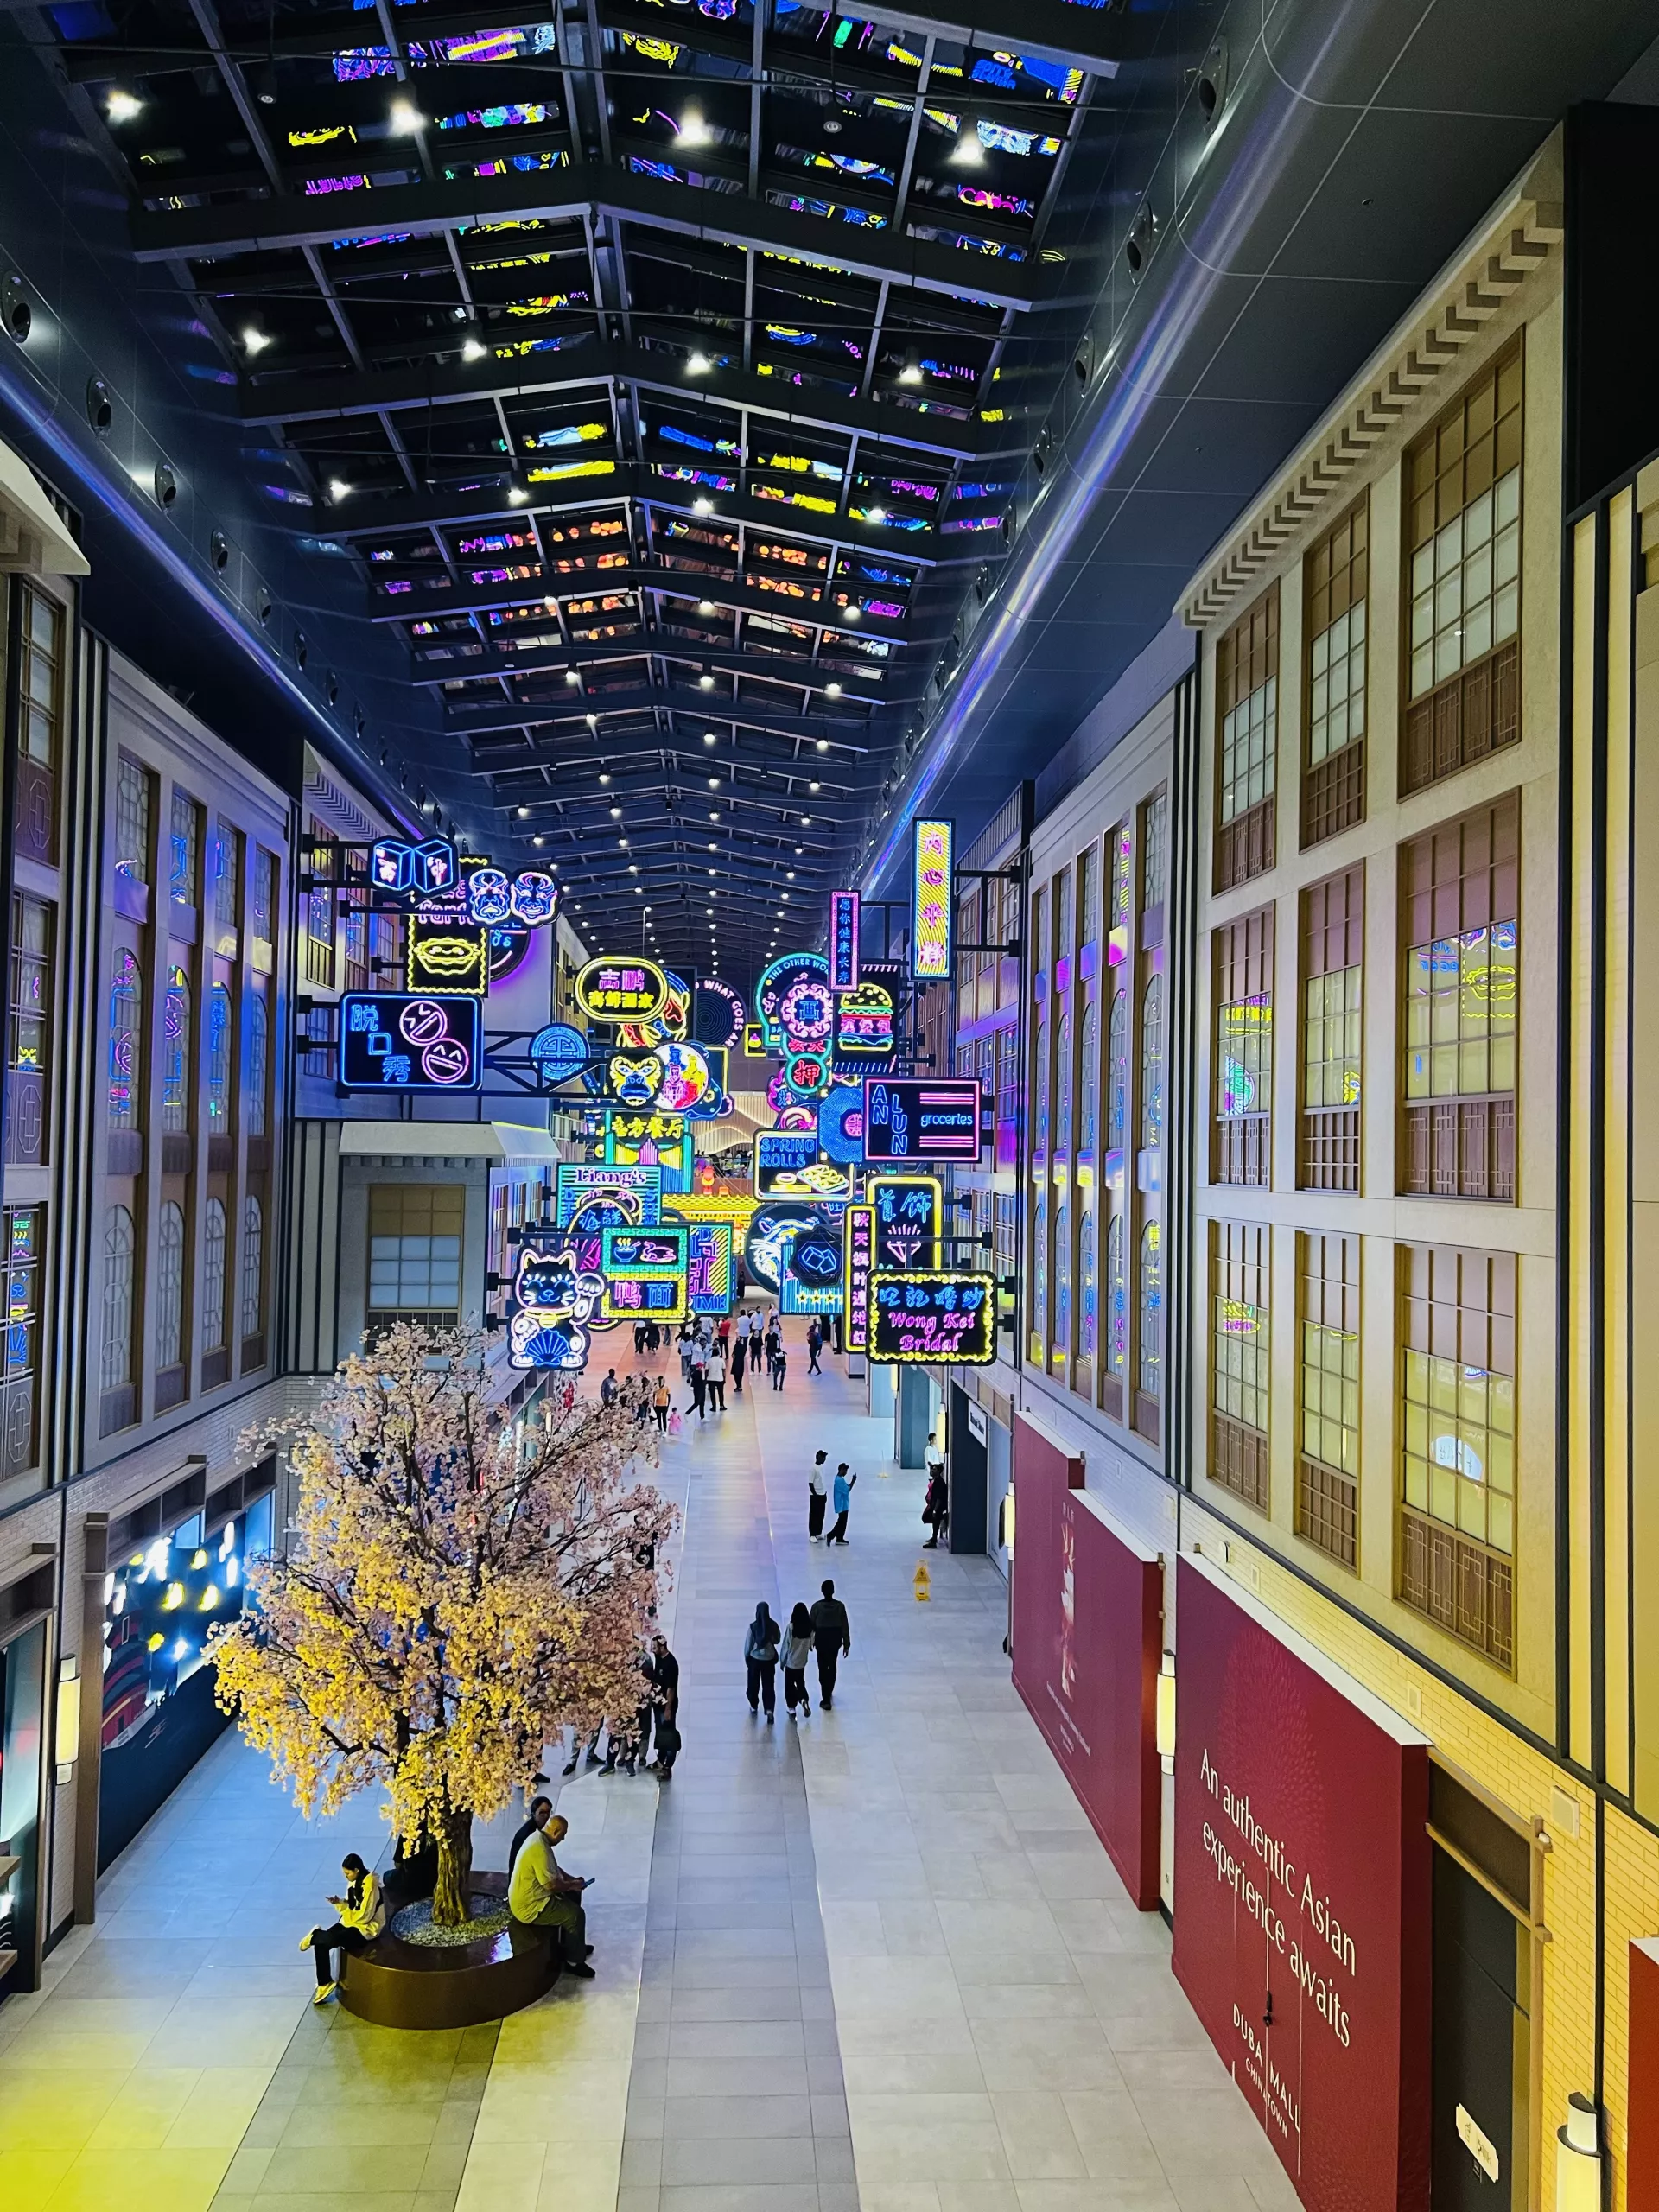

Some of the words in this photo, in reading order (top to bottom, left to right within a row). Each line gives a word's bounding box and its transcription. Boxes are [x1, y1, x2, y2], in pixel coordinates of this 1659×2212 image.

[919, 830, 945, 966] 内心平静
[837, 898, 851, 984] 愿你健康长寿
[768, 965, 783, 981] THE
[783, 958, 810, 969] OTHER
[703, 979, 735, 1000] WHAT
[731, 1001, 745, 1031] GOES
[351, 1003, 410, 1082] 脱口秀
[793, 1058, 821, 1087] 押
[920, 1113, 974, 1128] groceries
[760, 1137, 815, 1153] SPRING
[760, 1153, 806, 1167] ROLLS
[574, 1166, 647, 1188] Liang's
[613, 1281, 674, 1309] 鸭面
[692, 1296, 727, 1311] IME
[888, 1312, 938, 1335] Wong
[943, 1311, 976, 1330] Kei
[899, 1332, 963, 1352] Bridal
[1200, 1748, 1219, 1800] An
[1223, 1784, 1296, 1898] authentic
[1301, 1872, 1356, 1976] Asian
[1203, 1821, 1285, 1954] experience
[1290, 1940, 1350, 2048] awaits
[1233, 2003, 1268, 2068] DUBA
[1269, 2060, 1300, 2133] MALL
